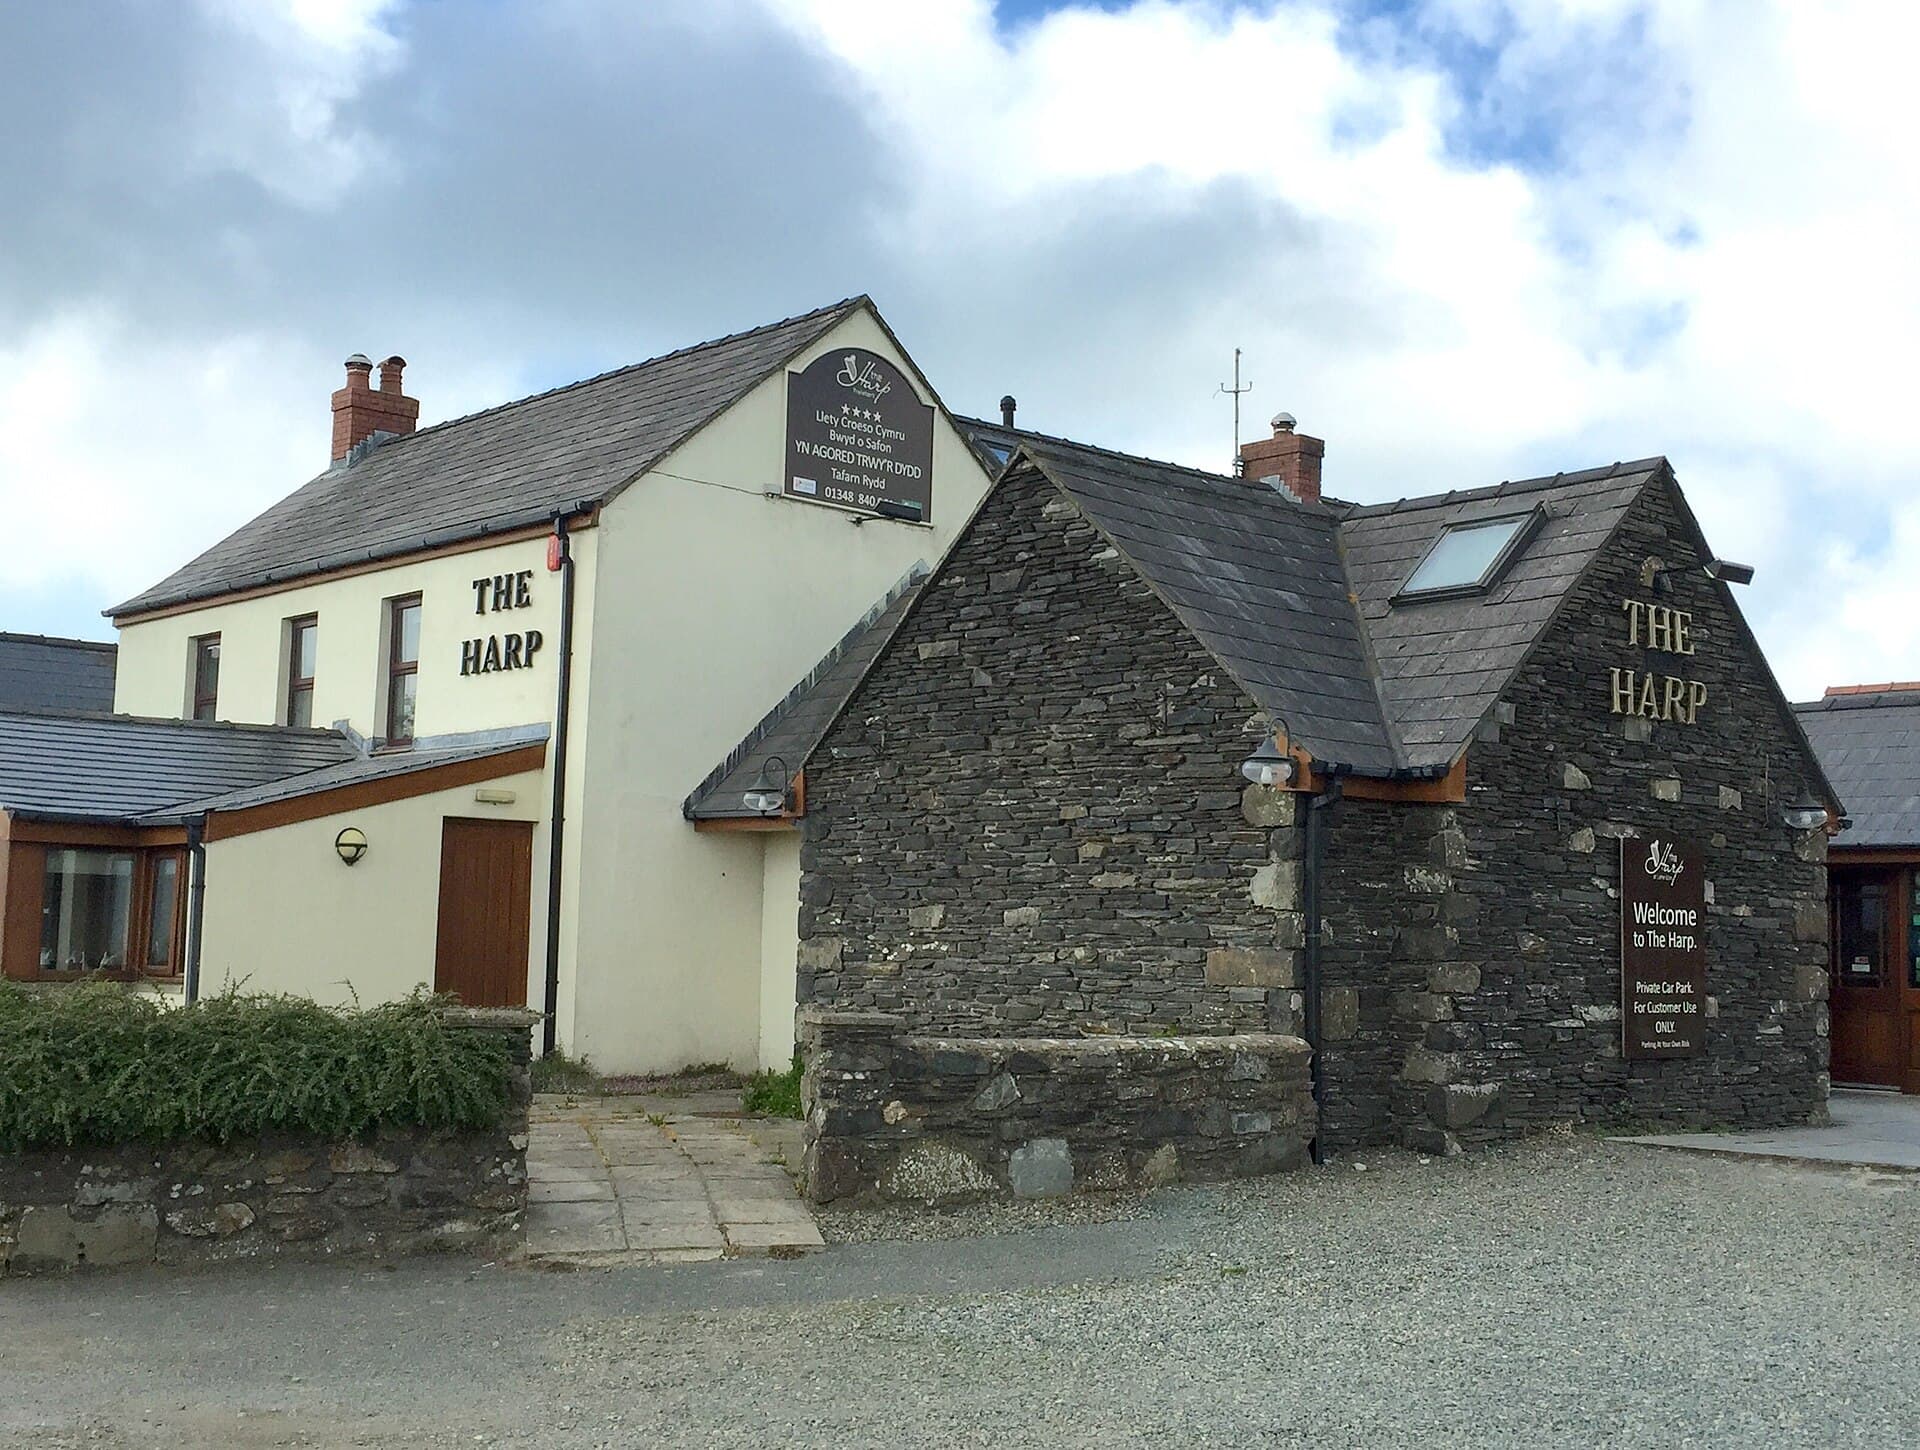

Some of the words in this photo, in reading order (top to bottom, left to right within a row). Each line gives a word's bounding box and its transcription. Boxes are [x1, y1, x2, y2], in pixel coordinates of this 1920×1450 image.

[816, 410, 840, 428] Llety
[841, 417, 874, 433] Croeso
[876, 426, 906, 441] Cymru
[829, 430, 856, 445] Bwyd
[857, 439, 865, 448] o
[866, 438, 892, 454] Safon
[795, 440, 810, 454] YN
[812, 443, 855, 464] AGORED
[856, 453, 894, 473] TRWY'R
[895, 463, 922, 479] DYDD
[831, 468, 861, 485] Tafarn
[862, 475, 886, 490] Rydd
[824, 487, 854, 502] 01348
[473, 569, 534, 615] THE
[1623, 599, 1695, 655] THE
[460, 630, 543, 676] HARP
[1610, 667, 1707, 724] HARP
[1633, 901, 1697, 927] Welcome
[1633, 931, 1645, 947] to
[1647, 930, 1666, 948] The
[1668, 931, 1697, 952] Harp.
[1636, 981, 1660, 994] Private
[1662, 982, 1674, 994] Car
[1634, 1001, 1646, 1014] For
[1647, 1001, 1681, 1014] Customer
[1683, 1001, 1697, 1014] Use
